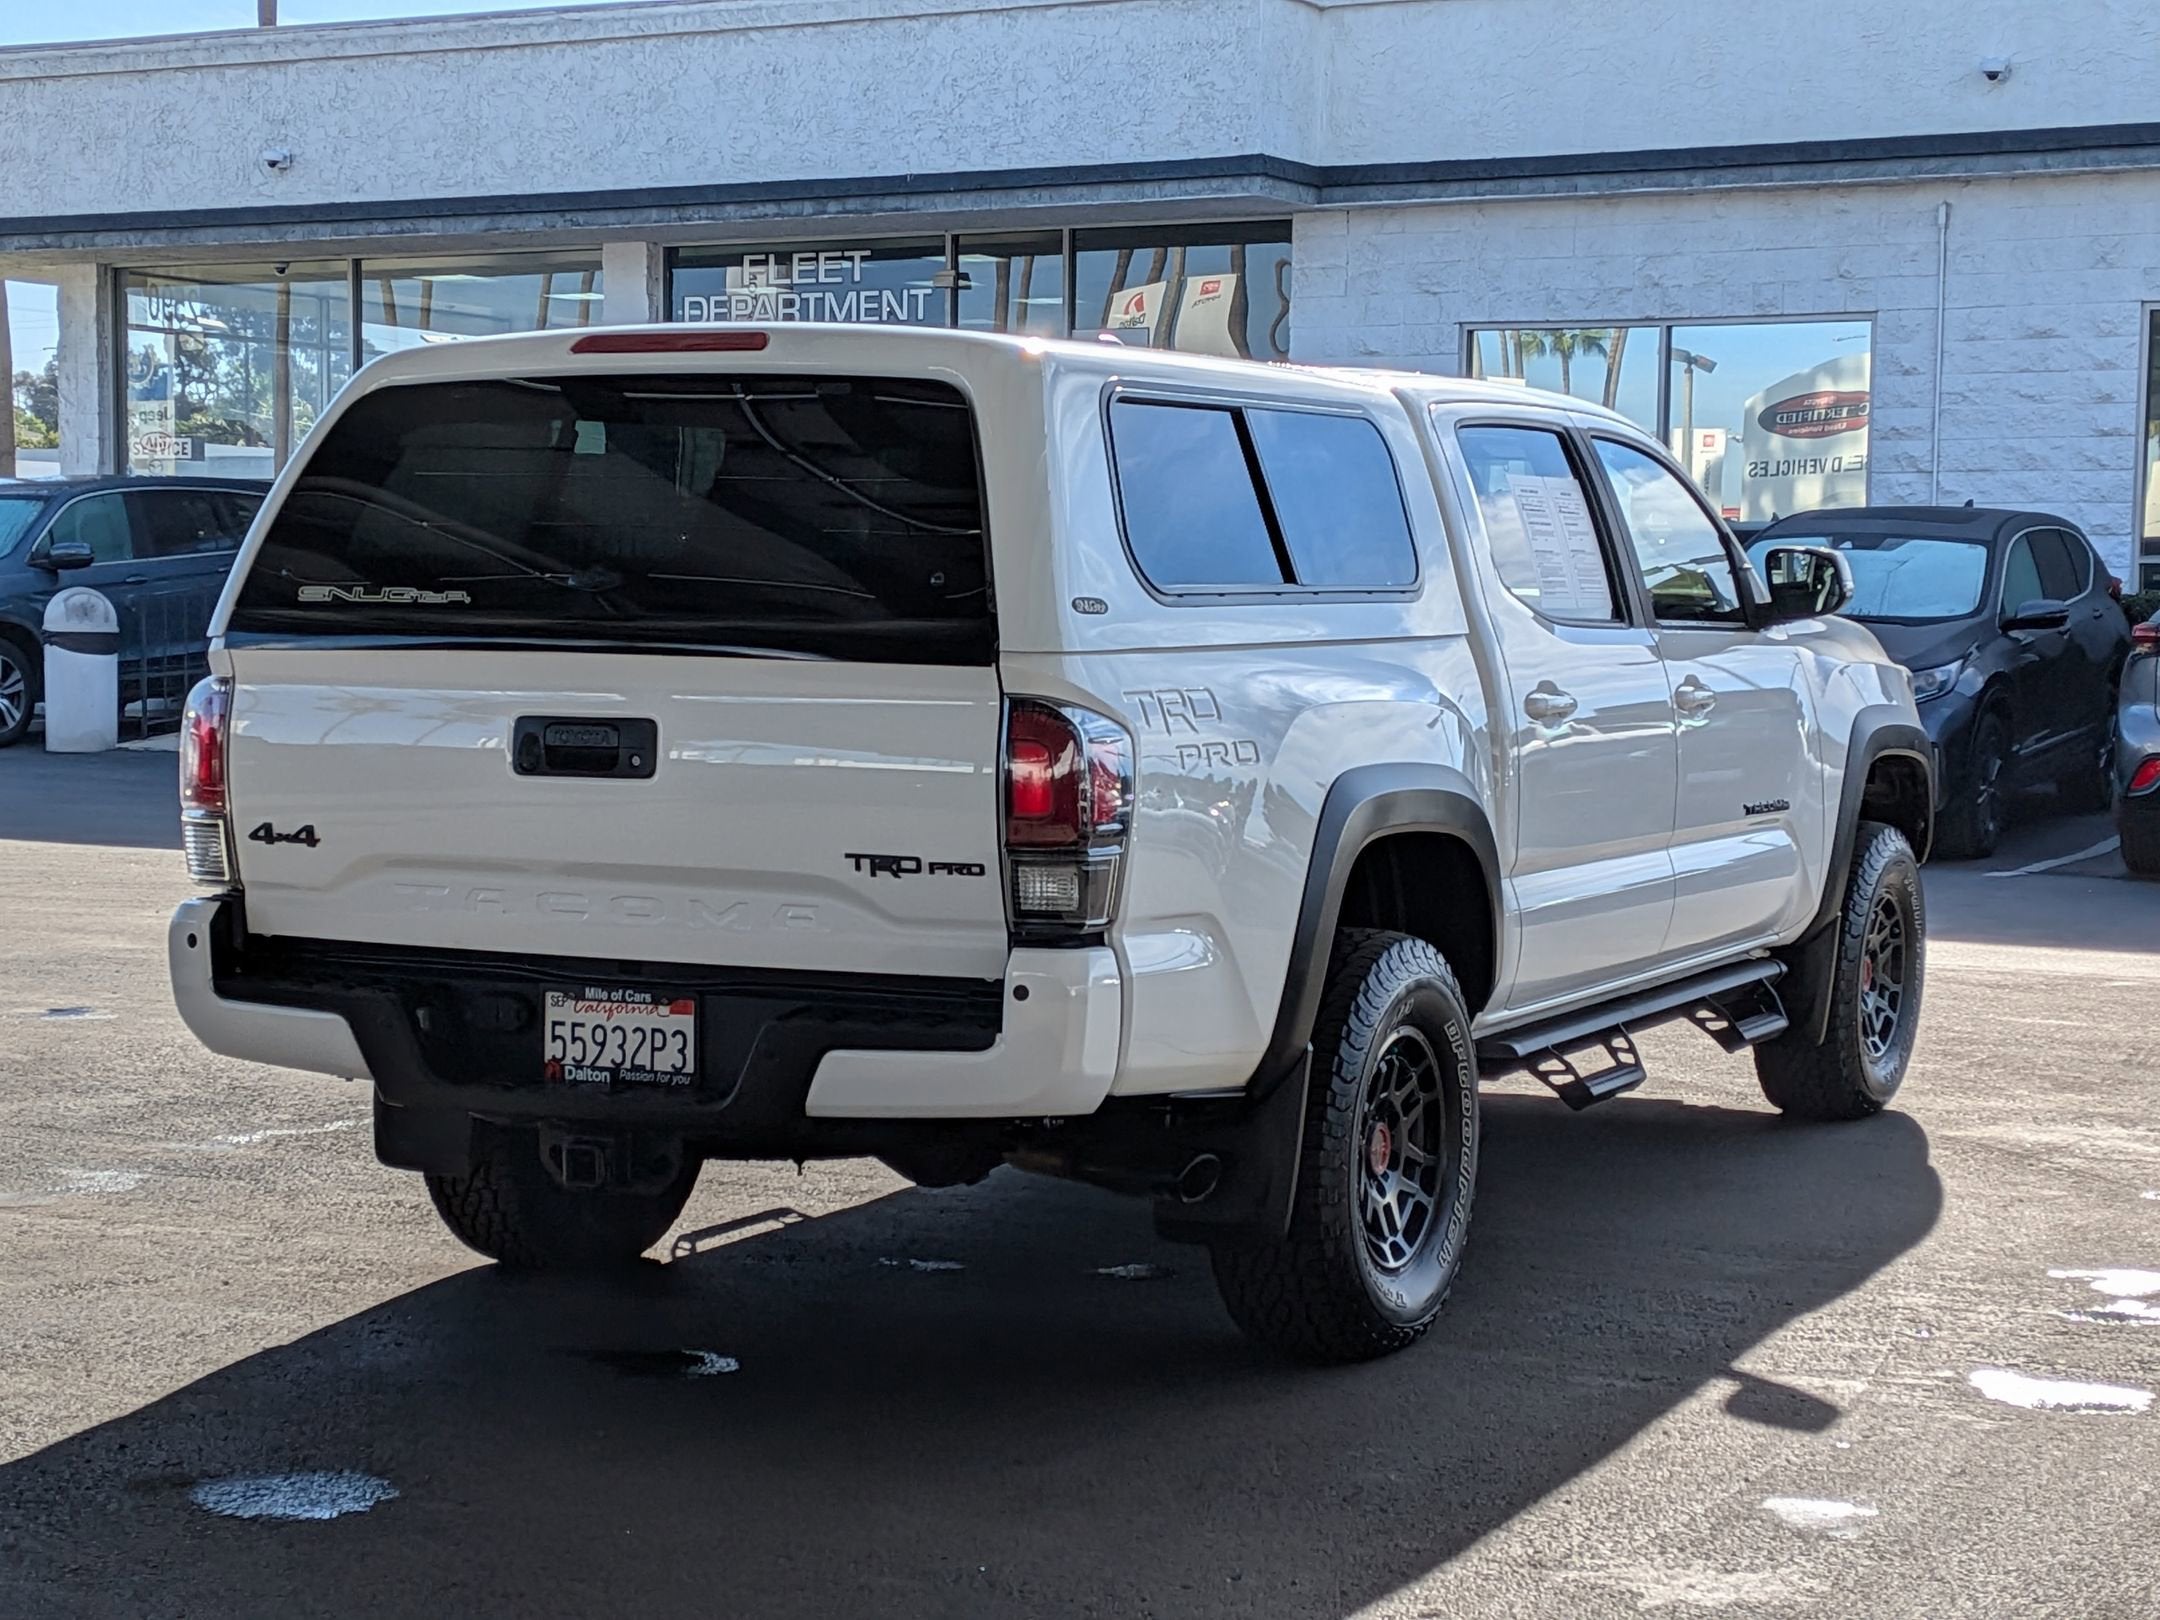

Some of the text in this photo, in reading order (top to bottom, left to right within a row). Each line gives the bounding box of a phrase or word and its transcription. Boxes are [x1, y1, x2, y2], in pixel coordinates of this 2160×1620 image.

[743, 250, 872, 285] FLEET
[684, 288, 932, 323] DEPARTMENT
[1122, 687, 1222, 737] TRD
[1175, 740, 1261, 771] PRO
[248, 822, 321, 848] 4x4
[844, 853, 986, 878] TRD PRO
[585, 986, 652, 1003] Mile of Cars
[573, 1000, 659, 1021] California
[551, 1020, 688, 1072] 55932P3
[564, 1066, 610, 1082] Dalton
